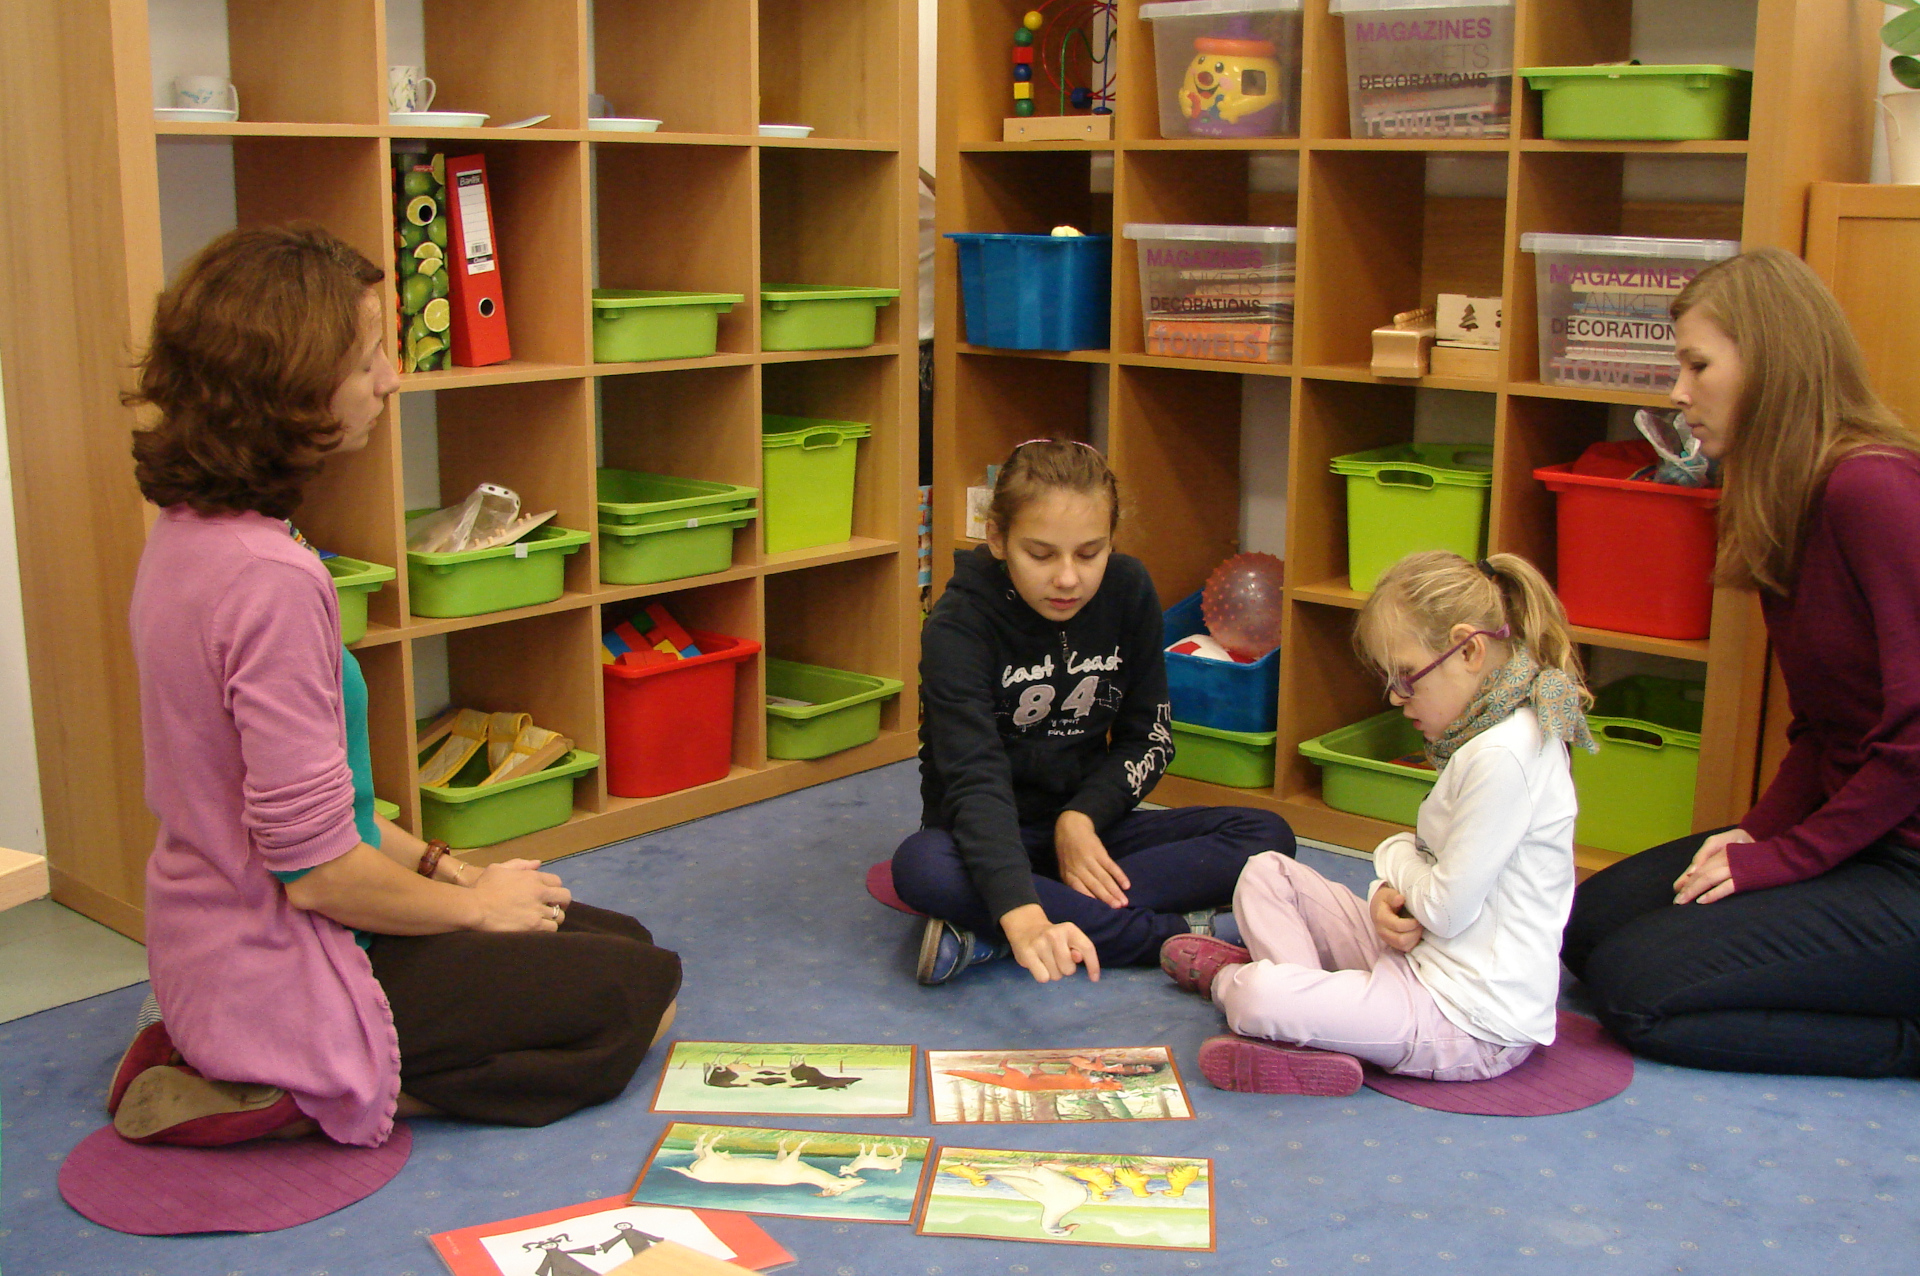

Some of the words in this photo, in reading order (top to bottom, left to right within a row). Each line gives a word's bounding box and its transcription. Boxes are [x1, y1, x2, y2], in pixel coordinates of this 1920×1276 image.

[1356, 17, 1492, 42] MAGAZINES
[1359, 72, 1488, 90] DECORATIONS
[1362, 110, 1485, 138] TOWELS
[1147, 248, 1263, 269] MAGAZINES
[1550, 263, 1698, 289] MAGAZINES
[1150, 296, 1262, 315] DECORATIONS
[1551, 317, 1676, 341] DECORATION
[1154, 330, 1262, 360] TOWELS
[1552, 356, 1680, 391] TOWEL
[1012, 675, 1100, 727] 84
